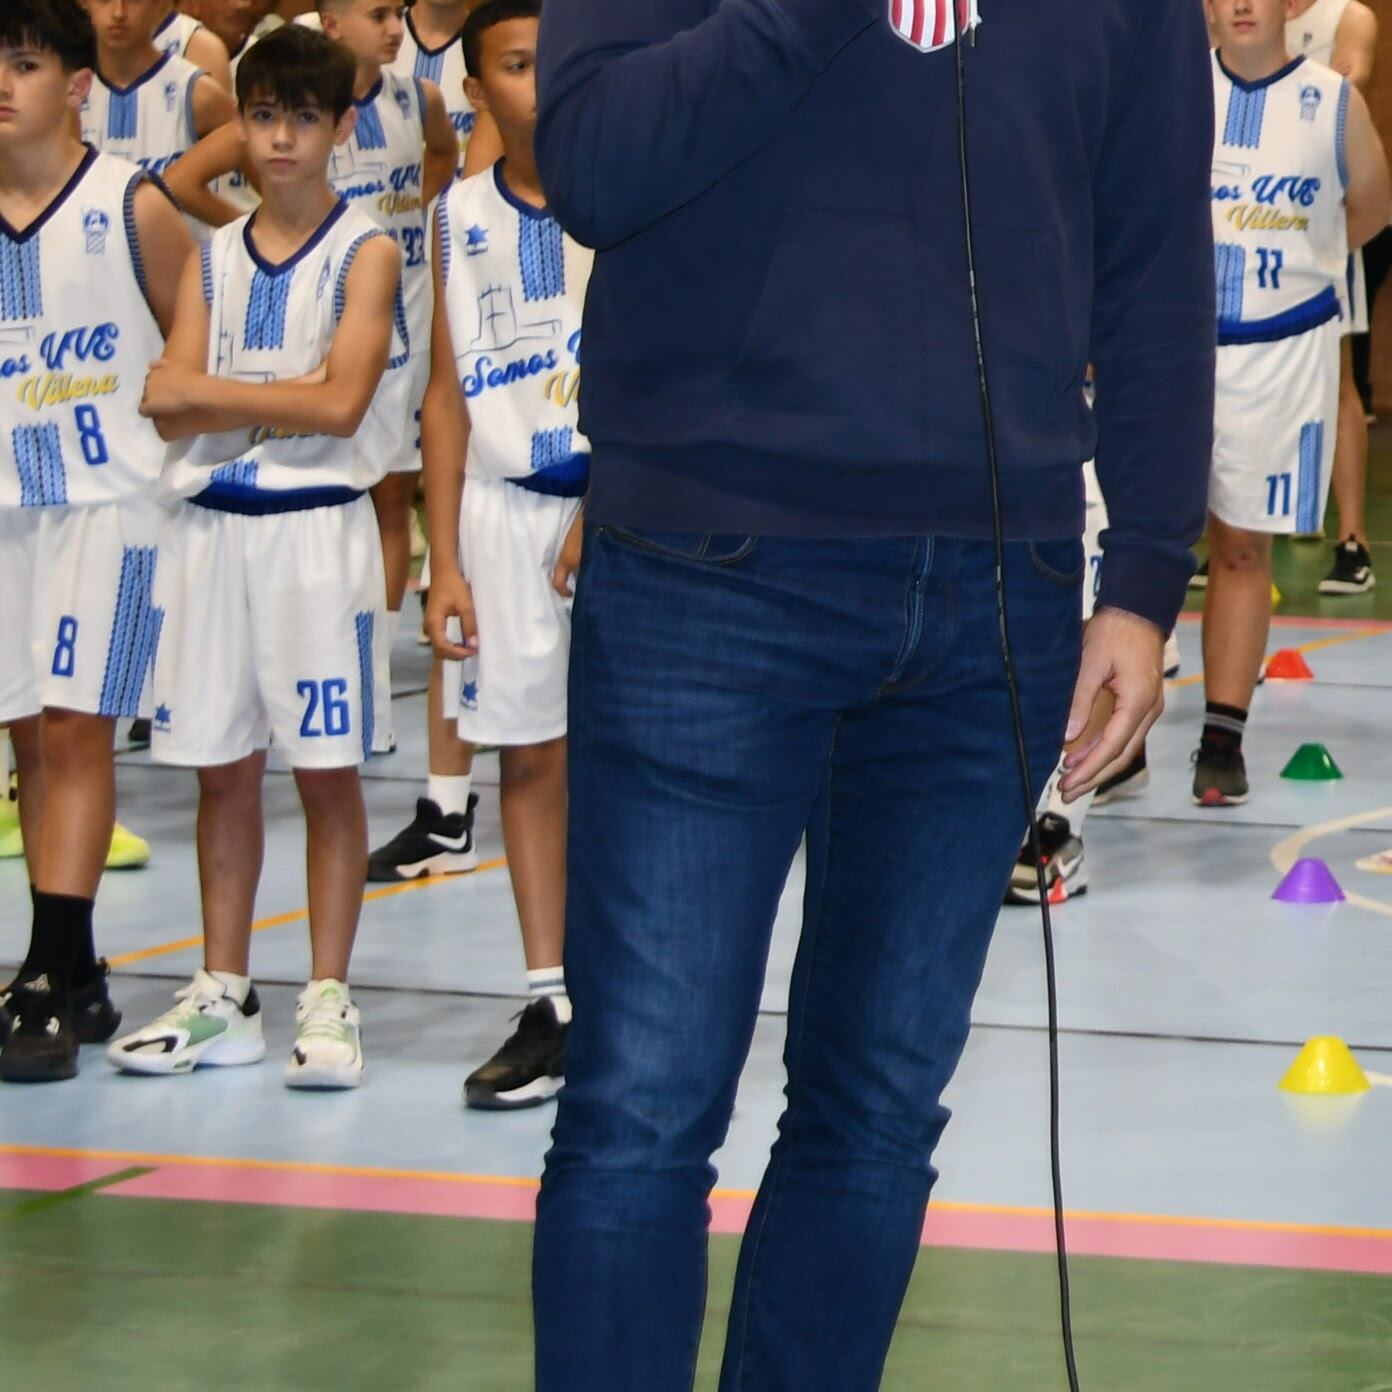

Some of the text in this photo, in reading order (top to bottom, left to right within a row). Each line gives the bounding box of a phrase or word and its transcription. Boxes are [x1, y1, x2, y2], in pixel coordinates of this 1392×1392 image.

[1252, 173, 1321, 206] UVE
[1256, 248, 1283, 290] 11
[39, 321, 120, 371] UVE
[462, 349, 559, 398] Somos
[73, 403, 109, 466] 8
[1265, 471, 1292, 516] 11
[51, 615, 78, 678] 8
[296, 677, 350, 738] 26
